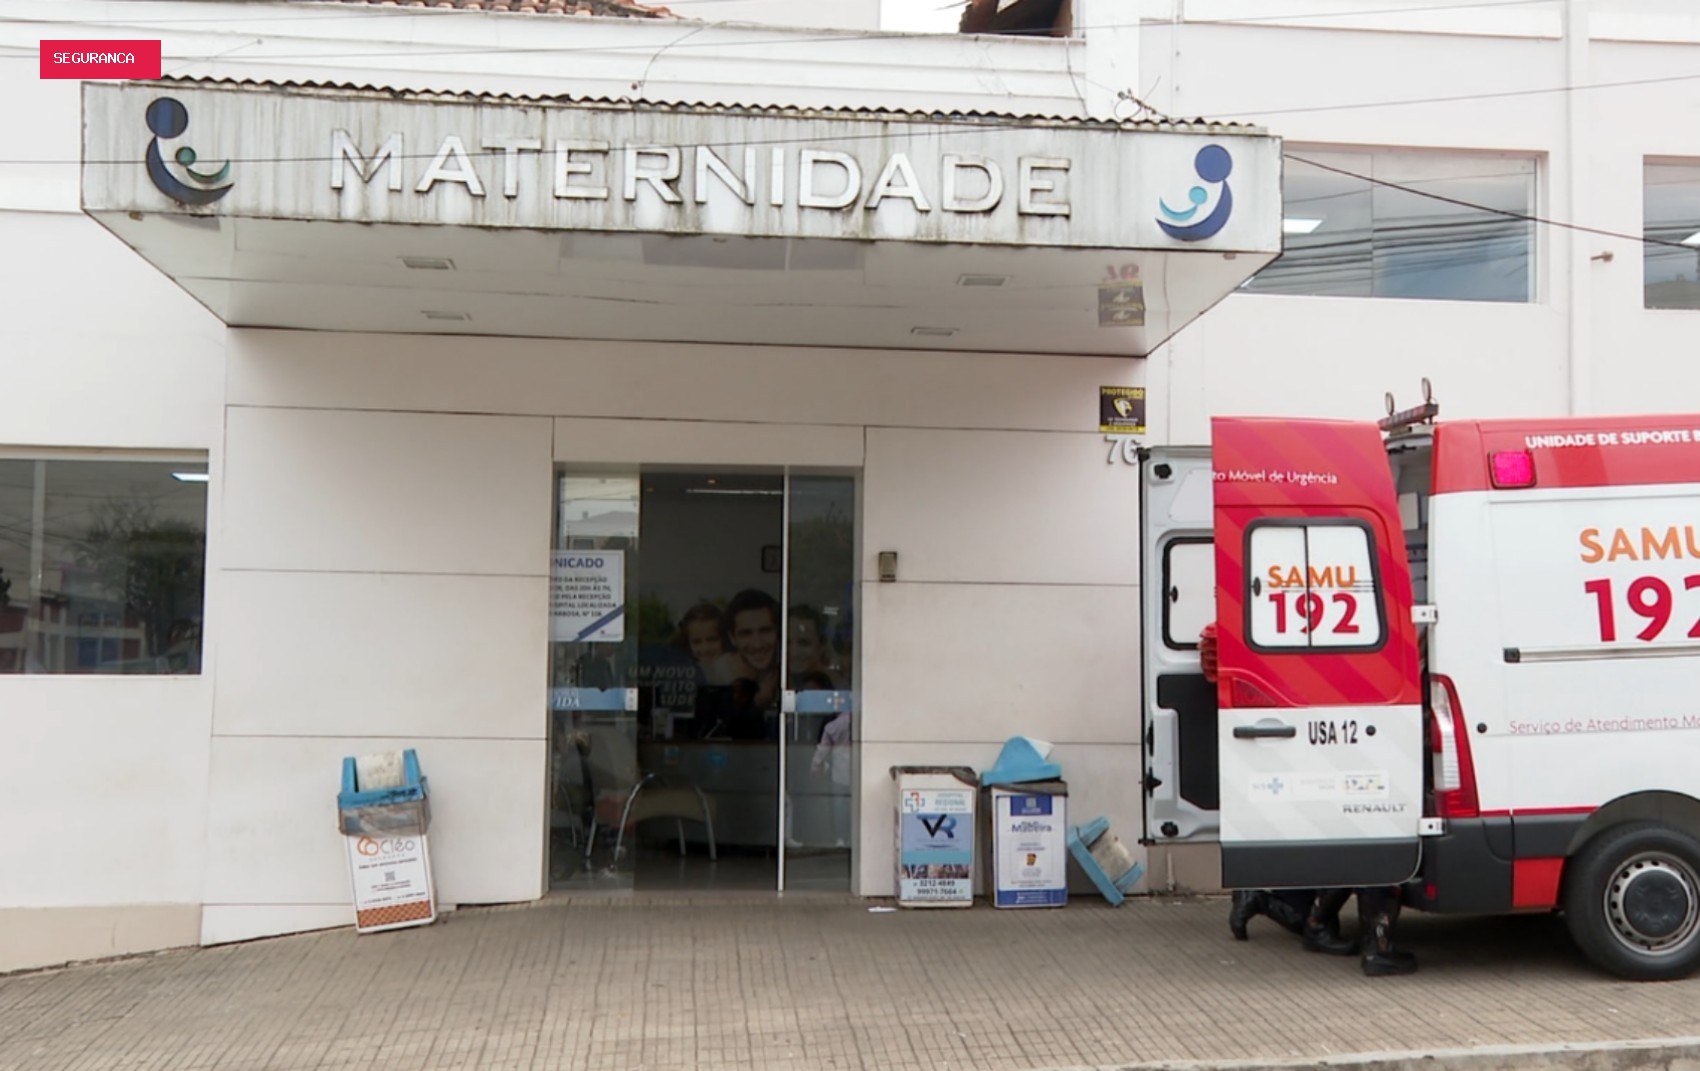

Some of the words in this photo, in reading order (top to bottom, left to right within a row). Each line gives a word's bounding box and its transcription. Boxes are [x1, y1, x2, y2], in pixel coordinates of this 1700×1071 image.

[330, 129, 1072, 217] MATERNIDADE
[1525, 434, 1596, 449] UNIDADE
[1598, 433, 1618, 445] DE
[1621, 430, 1691, 445] SUPORTE
[1228, 469, 1266, 482] Móvel
[1268, 469, 1285, 482] de
[1286, 470, 1338, 487] Urgência
[1267, 565, 1355, 588] SAMU
[1268, 592, 1360, 634] 192
[654, 666, 697, 679] NOVO
[1308, 720, 1337, 745] USA
[1341, 719, 1358, 744] 12
[1509, 720, 1561, 734] Serviço
[1564, 718, 1583, 732] de
[1587, 716, 1678, 731] Atendimento
[1682, 714, 1700, 728] M
[1343, 803, 1407, 814] RENAULT
